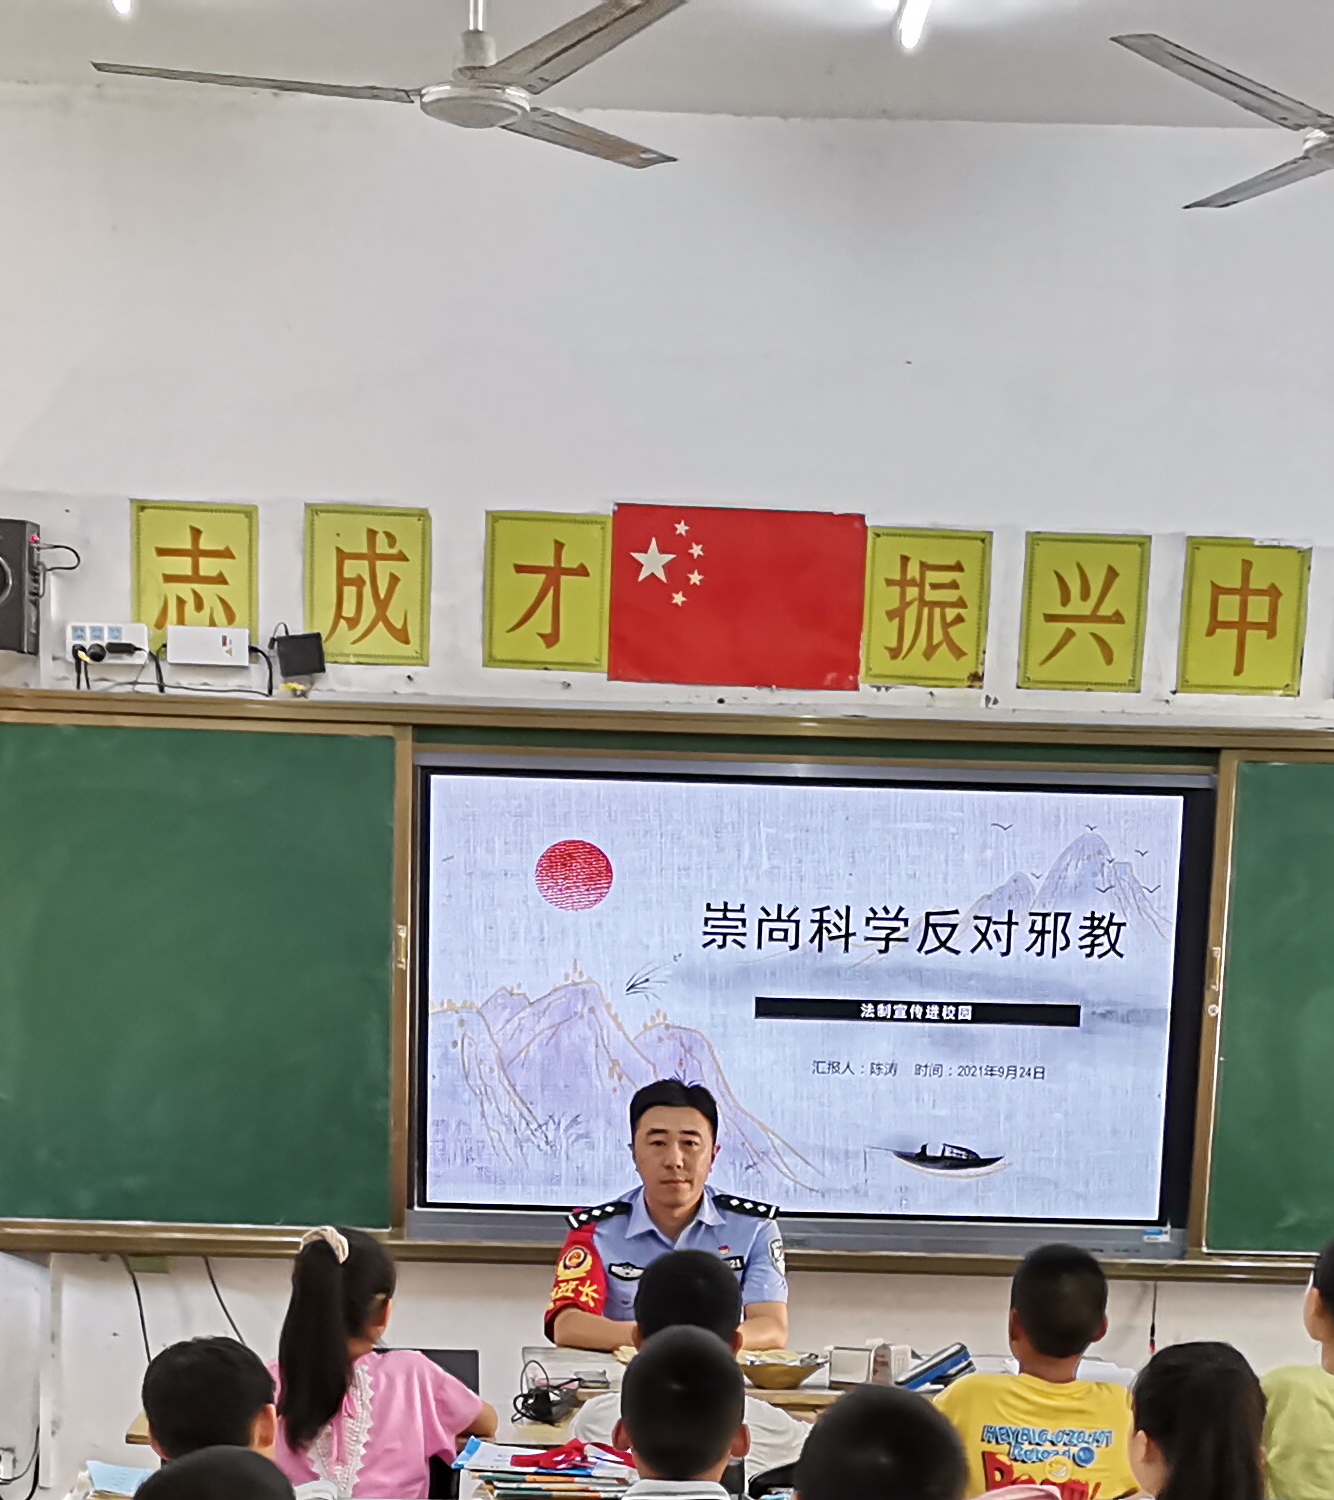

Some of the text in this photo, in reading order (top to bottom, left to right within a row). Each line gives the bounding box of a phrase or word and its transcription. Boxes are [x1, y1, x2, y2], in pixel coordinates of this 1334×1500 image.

[701, 901, 1128, 960] 崇尚科学反对邪教
[860, 1003, 974, 1021] 法制宣传进校园
